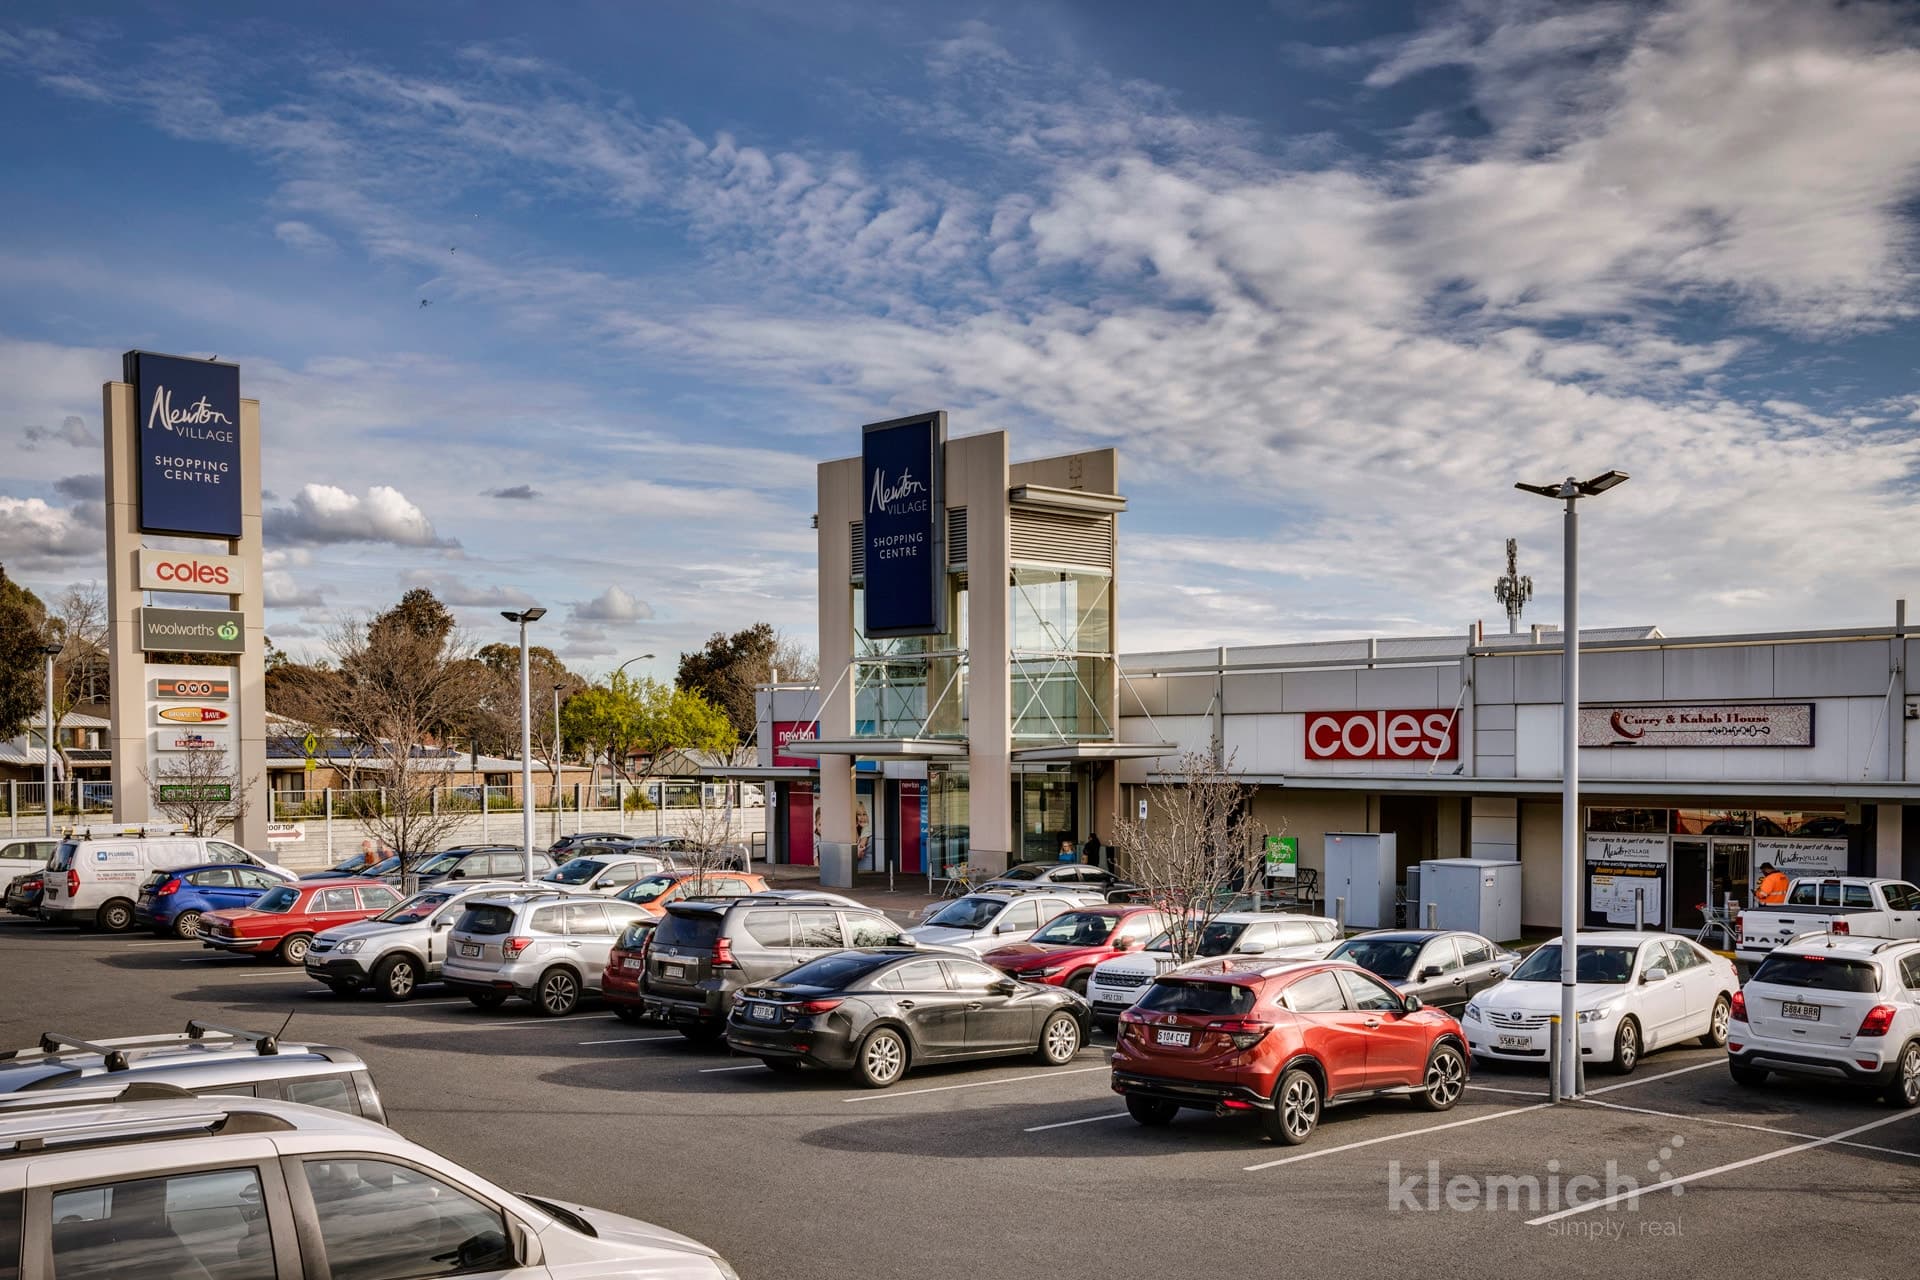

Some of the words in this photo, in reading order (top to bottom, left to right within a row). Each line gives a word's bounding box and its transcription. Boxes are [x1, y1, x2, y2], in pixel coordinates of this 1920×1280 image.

[148, 385, 232, 431] Newton
[176, 426, 233, 443] VILLAGE
[155, 455, 229, 472] SHOPPING
[164, 469, 220, 484] CENTRE
[869, 467, 927, 514] Newton
[887, 500, 928, 516] VILLAGE
[873, 532, 923, 548] SHOPPING
[879, 546, 917, 560] CENTRE
[156, 560, 229, 585] coles
[148, 622, 215, 637] Woolworths
[178, 683, 209, 693] BWS
[1623, 715, 1661, 726] Curry
[1666, 715, 1676, 724] &
[1680, 713, 1722, 724] Kabab
[1727, 713, 1769, 723] House
[779, 728, 815, 742] newton
[1308, 710, 1451, 757] coles
[1745, 936, 1784, 944] RAN
